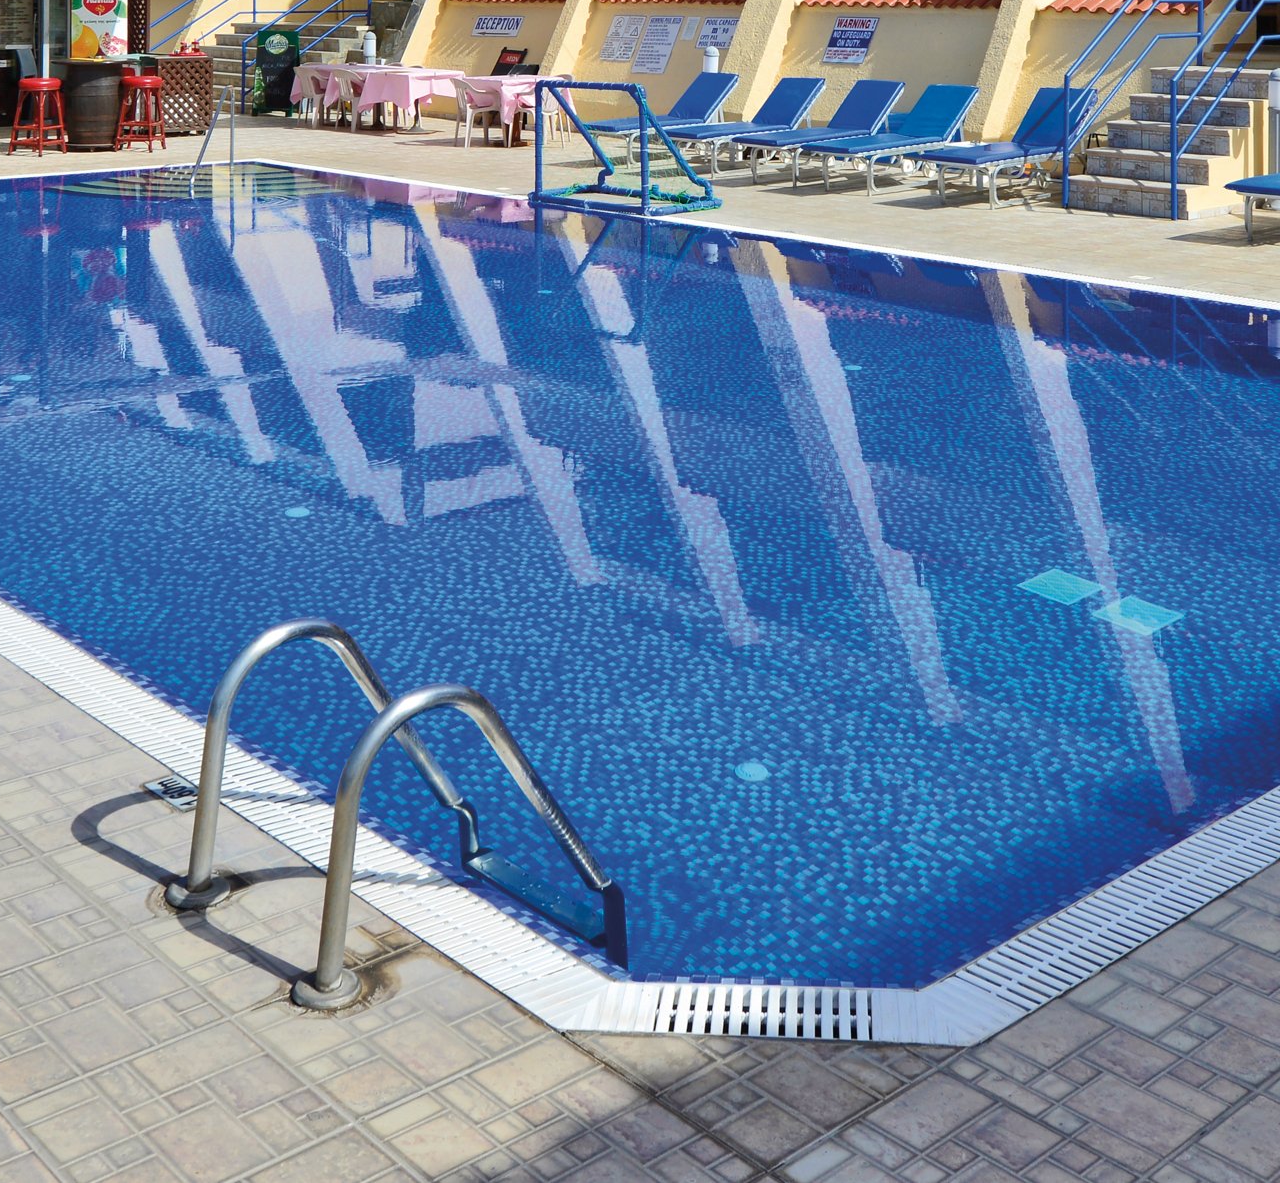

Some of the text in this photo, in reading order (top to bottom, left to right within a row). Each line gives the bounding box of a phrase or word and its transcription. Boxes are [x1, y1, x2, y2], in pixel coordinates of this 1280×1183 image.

[475, 17, 522, 30] RECEPTION
[837, 18, 871, 29] WARNING
[841, 31, 872, 39] LIFEGUARD
[836, 39, 846, 47] ON
